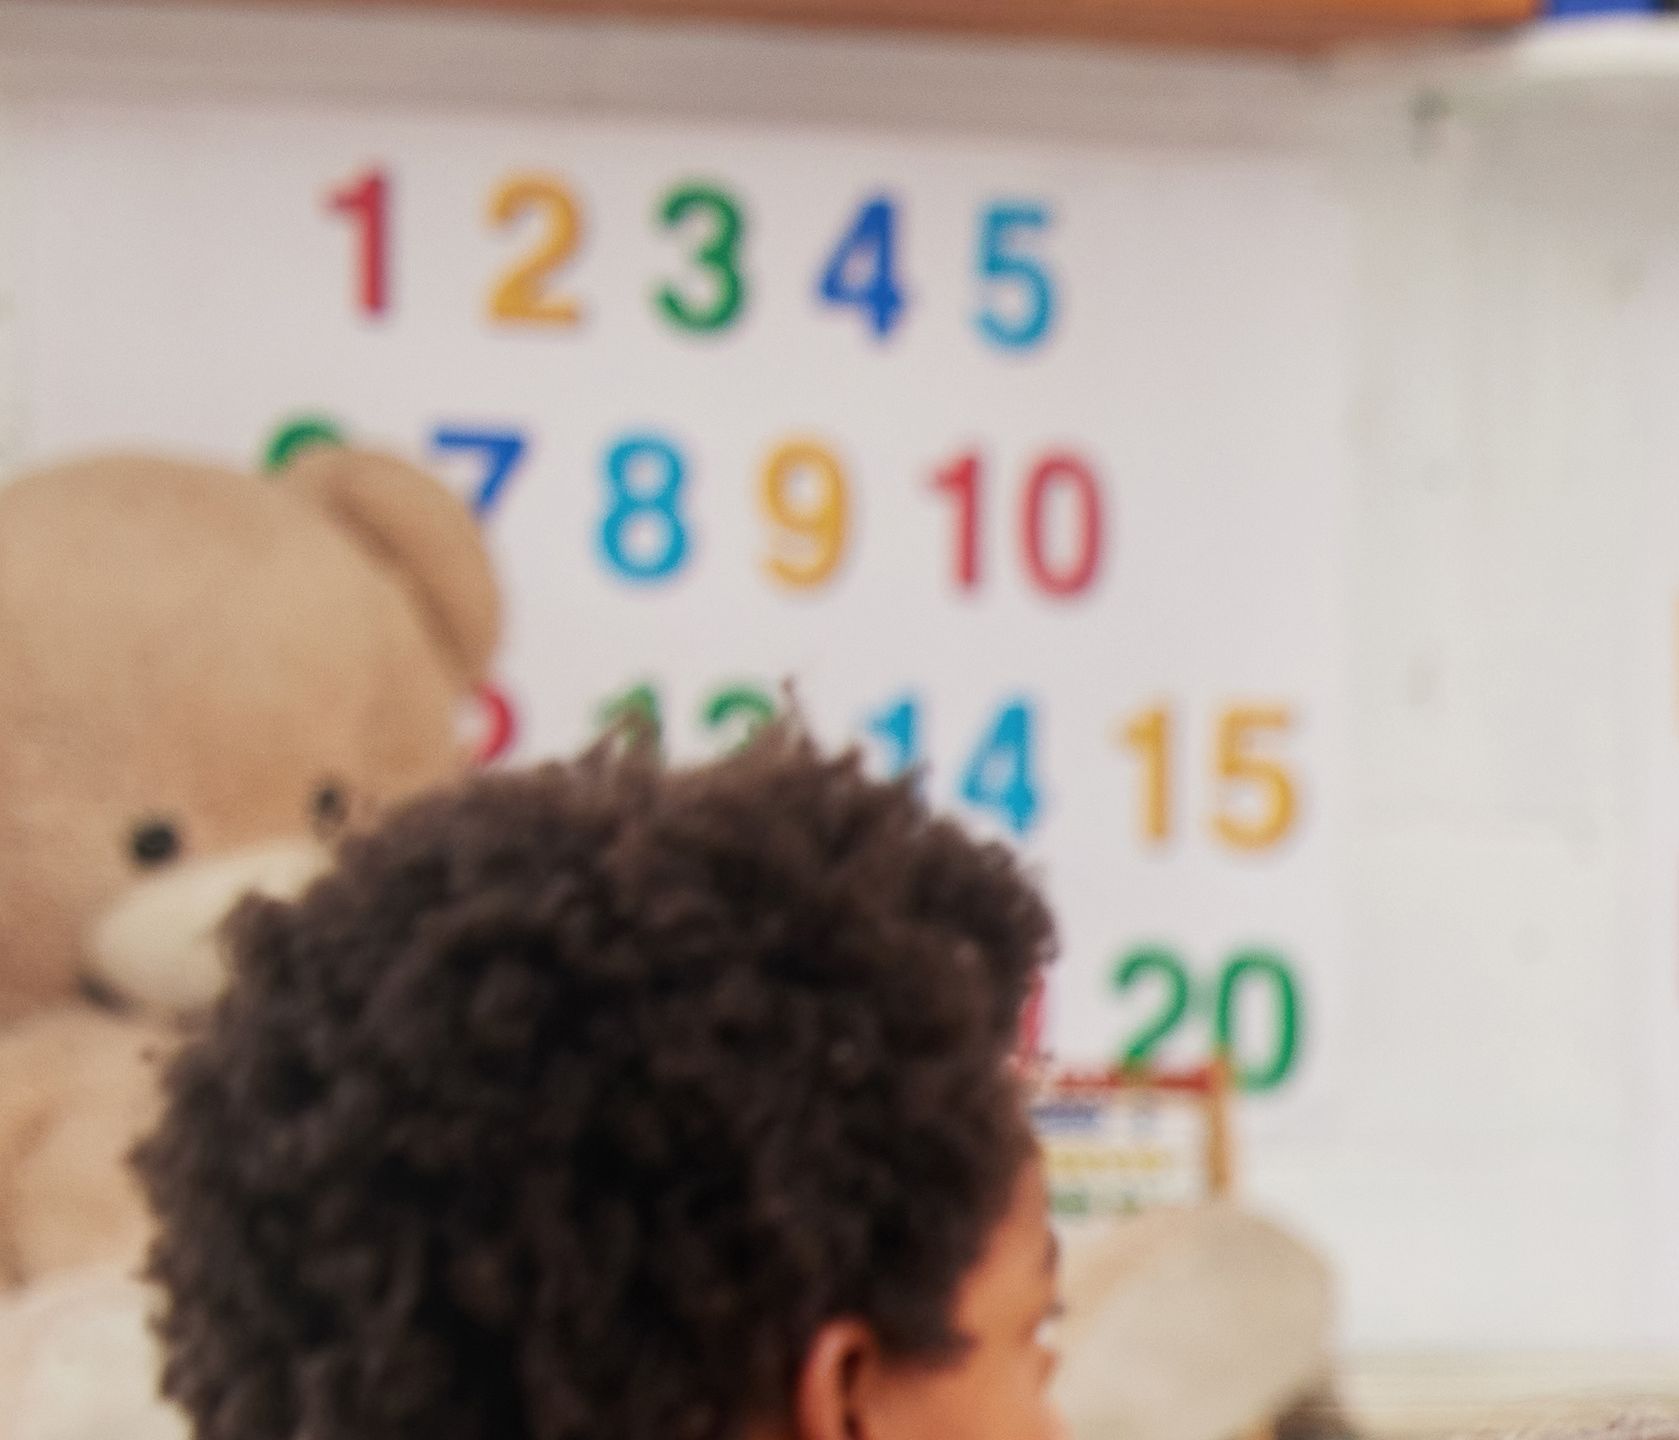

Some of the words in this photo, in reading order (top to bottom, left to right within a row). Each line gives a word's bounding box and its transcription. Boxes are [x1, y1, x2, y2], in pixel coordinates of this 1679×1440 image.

[325, 164, 392, 320] 1
[481, 168, 586, 330] 2
[656, 185, 745, 333] 3
[817, 196, 906, 339] 4
[975, 201, 1056, 352] 5
[593, 430, 694, 586] 8
[753, 432, 854, 593] 9
[927, 447, 1107, 601] 10
[866, 694, 1044, 838] 14
[1119, 700, 1302, 855] 15
[1111, 946, 1304, 1096] 20
